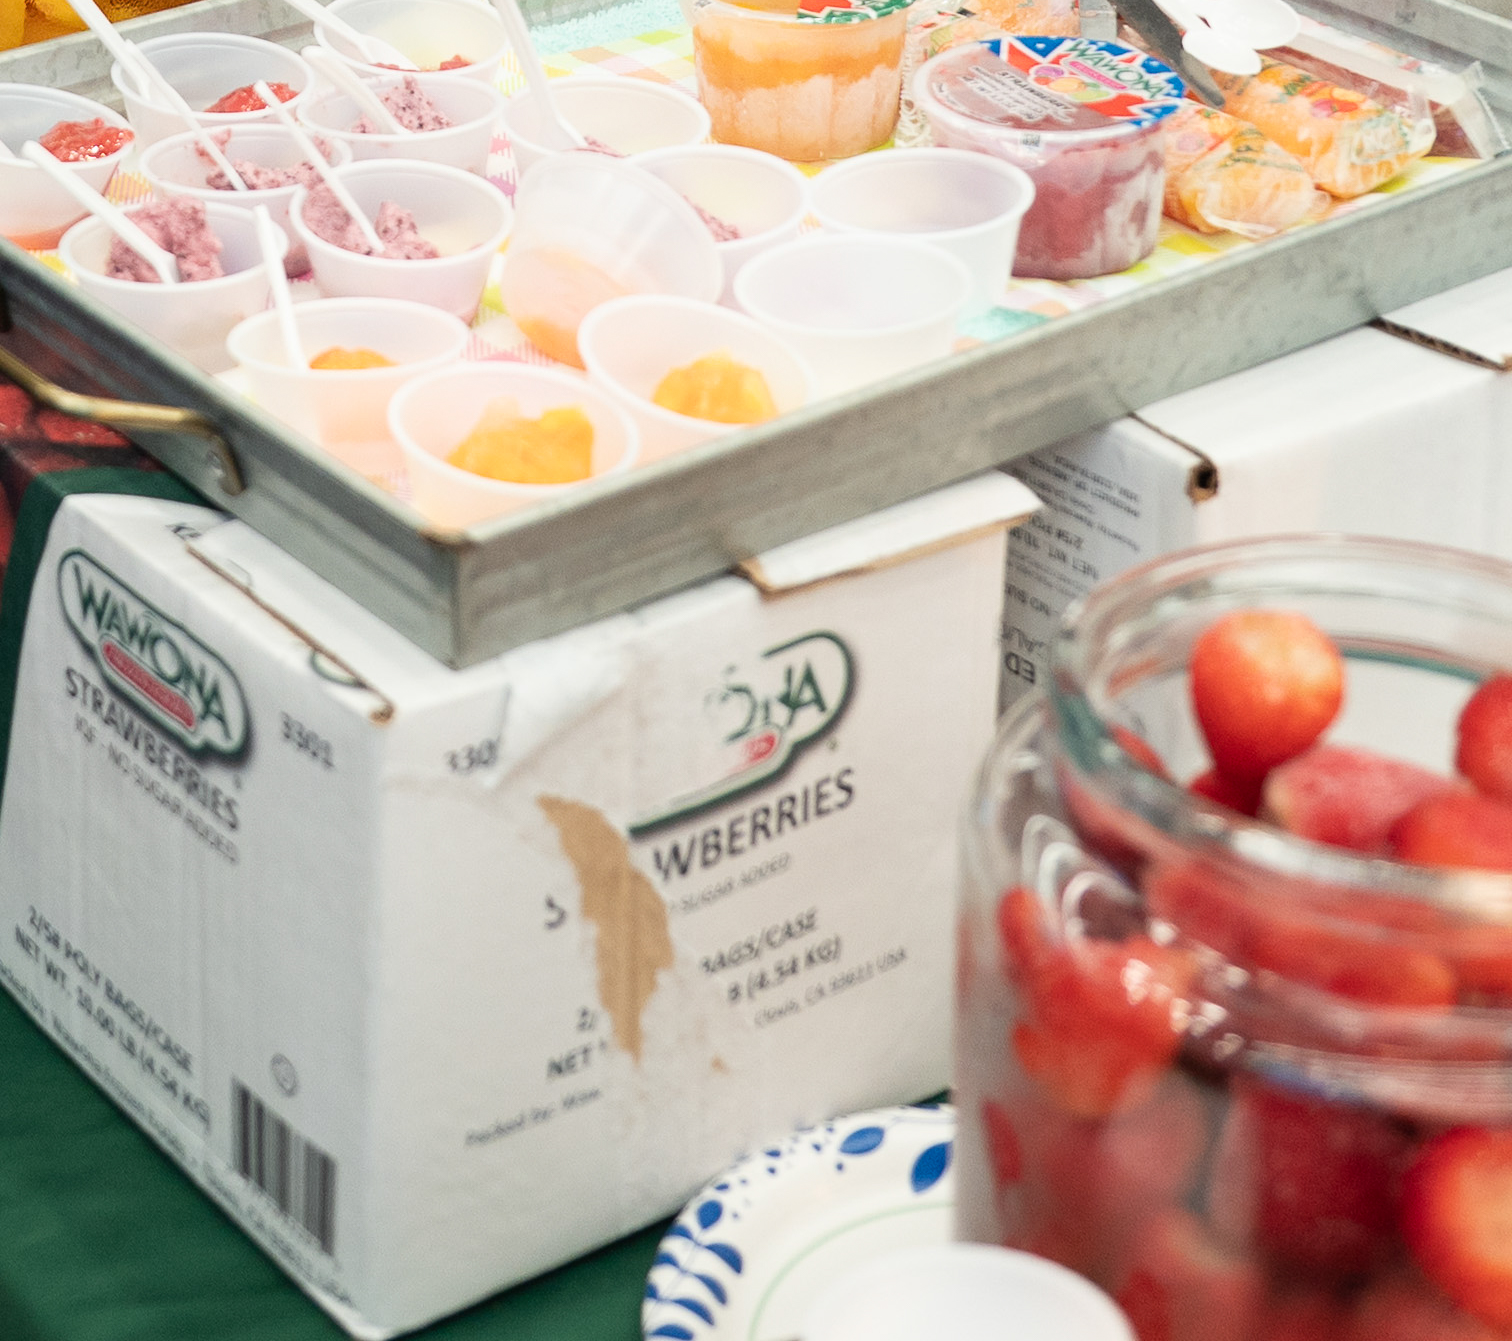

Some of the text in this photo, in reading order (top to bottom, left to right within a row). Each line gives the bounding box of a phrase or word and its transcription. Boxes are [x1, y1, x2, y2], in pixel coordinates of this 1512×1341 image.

[998, 71, 1075, 111] STRAWBERRY
[1066, 39, 1166, 99] WAWONA
[73, 561, 232, 741] WAWONA
[65, 665, 239, 831] STRAWBERRIES
[13, 922, 42, 964] NET
